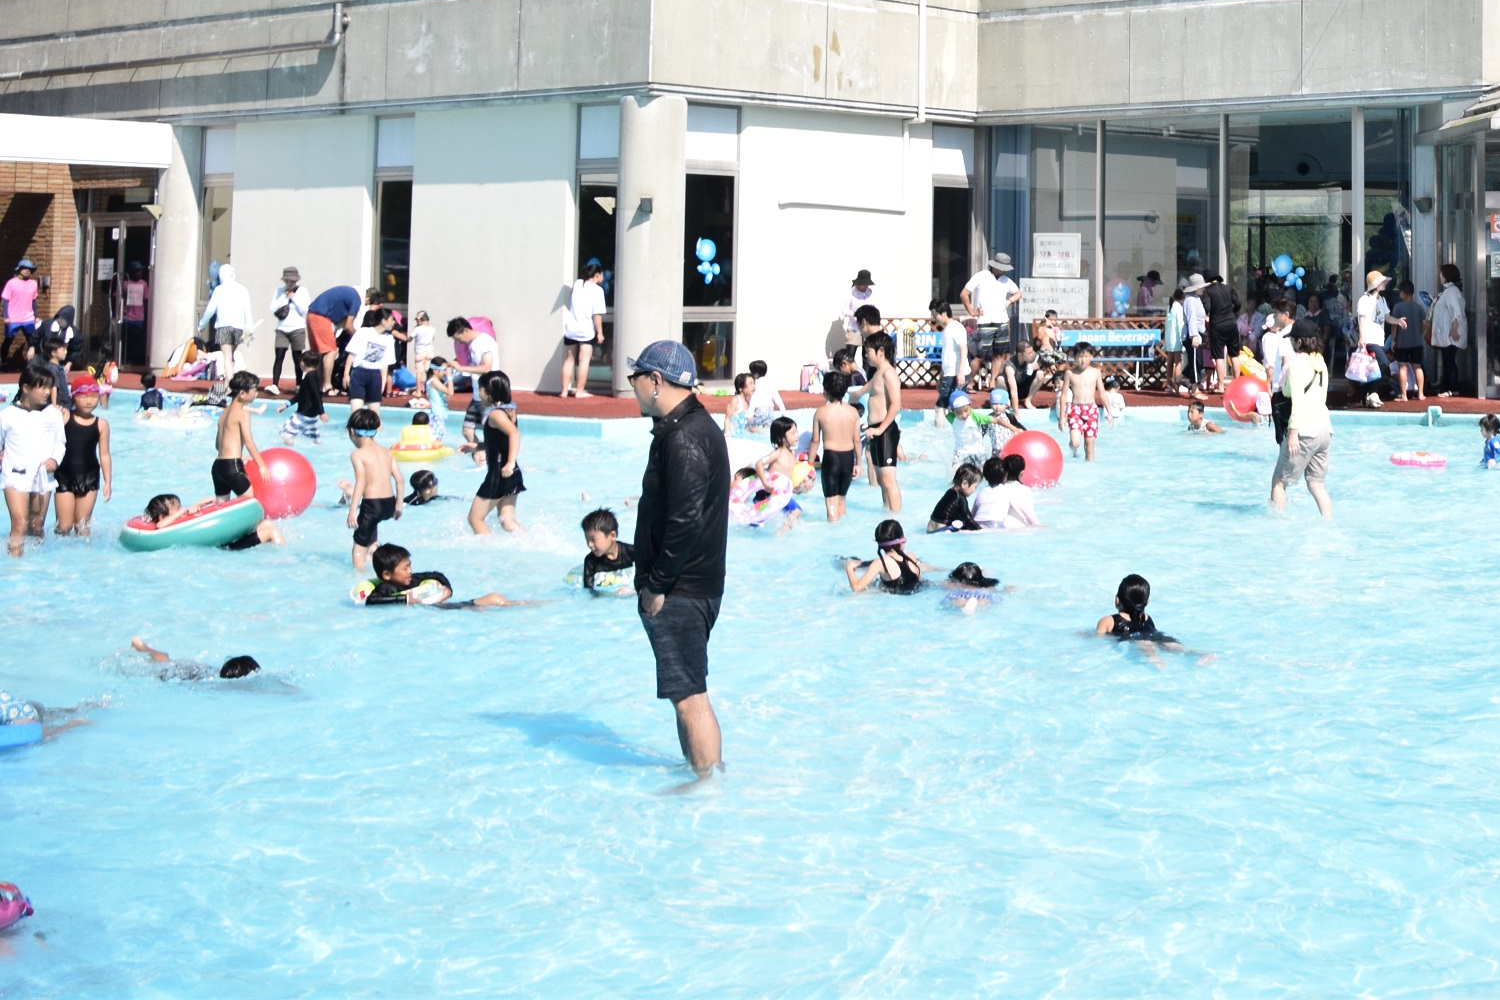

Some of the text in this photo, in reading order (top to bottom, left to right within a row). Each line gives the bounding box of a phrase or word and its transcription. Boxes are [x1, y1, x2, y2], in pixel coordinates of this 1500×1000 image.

[915, 334, 937, 346] RIN
[1077, 332, 1155, 343] Japan Beverage
